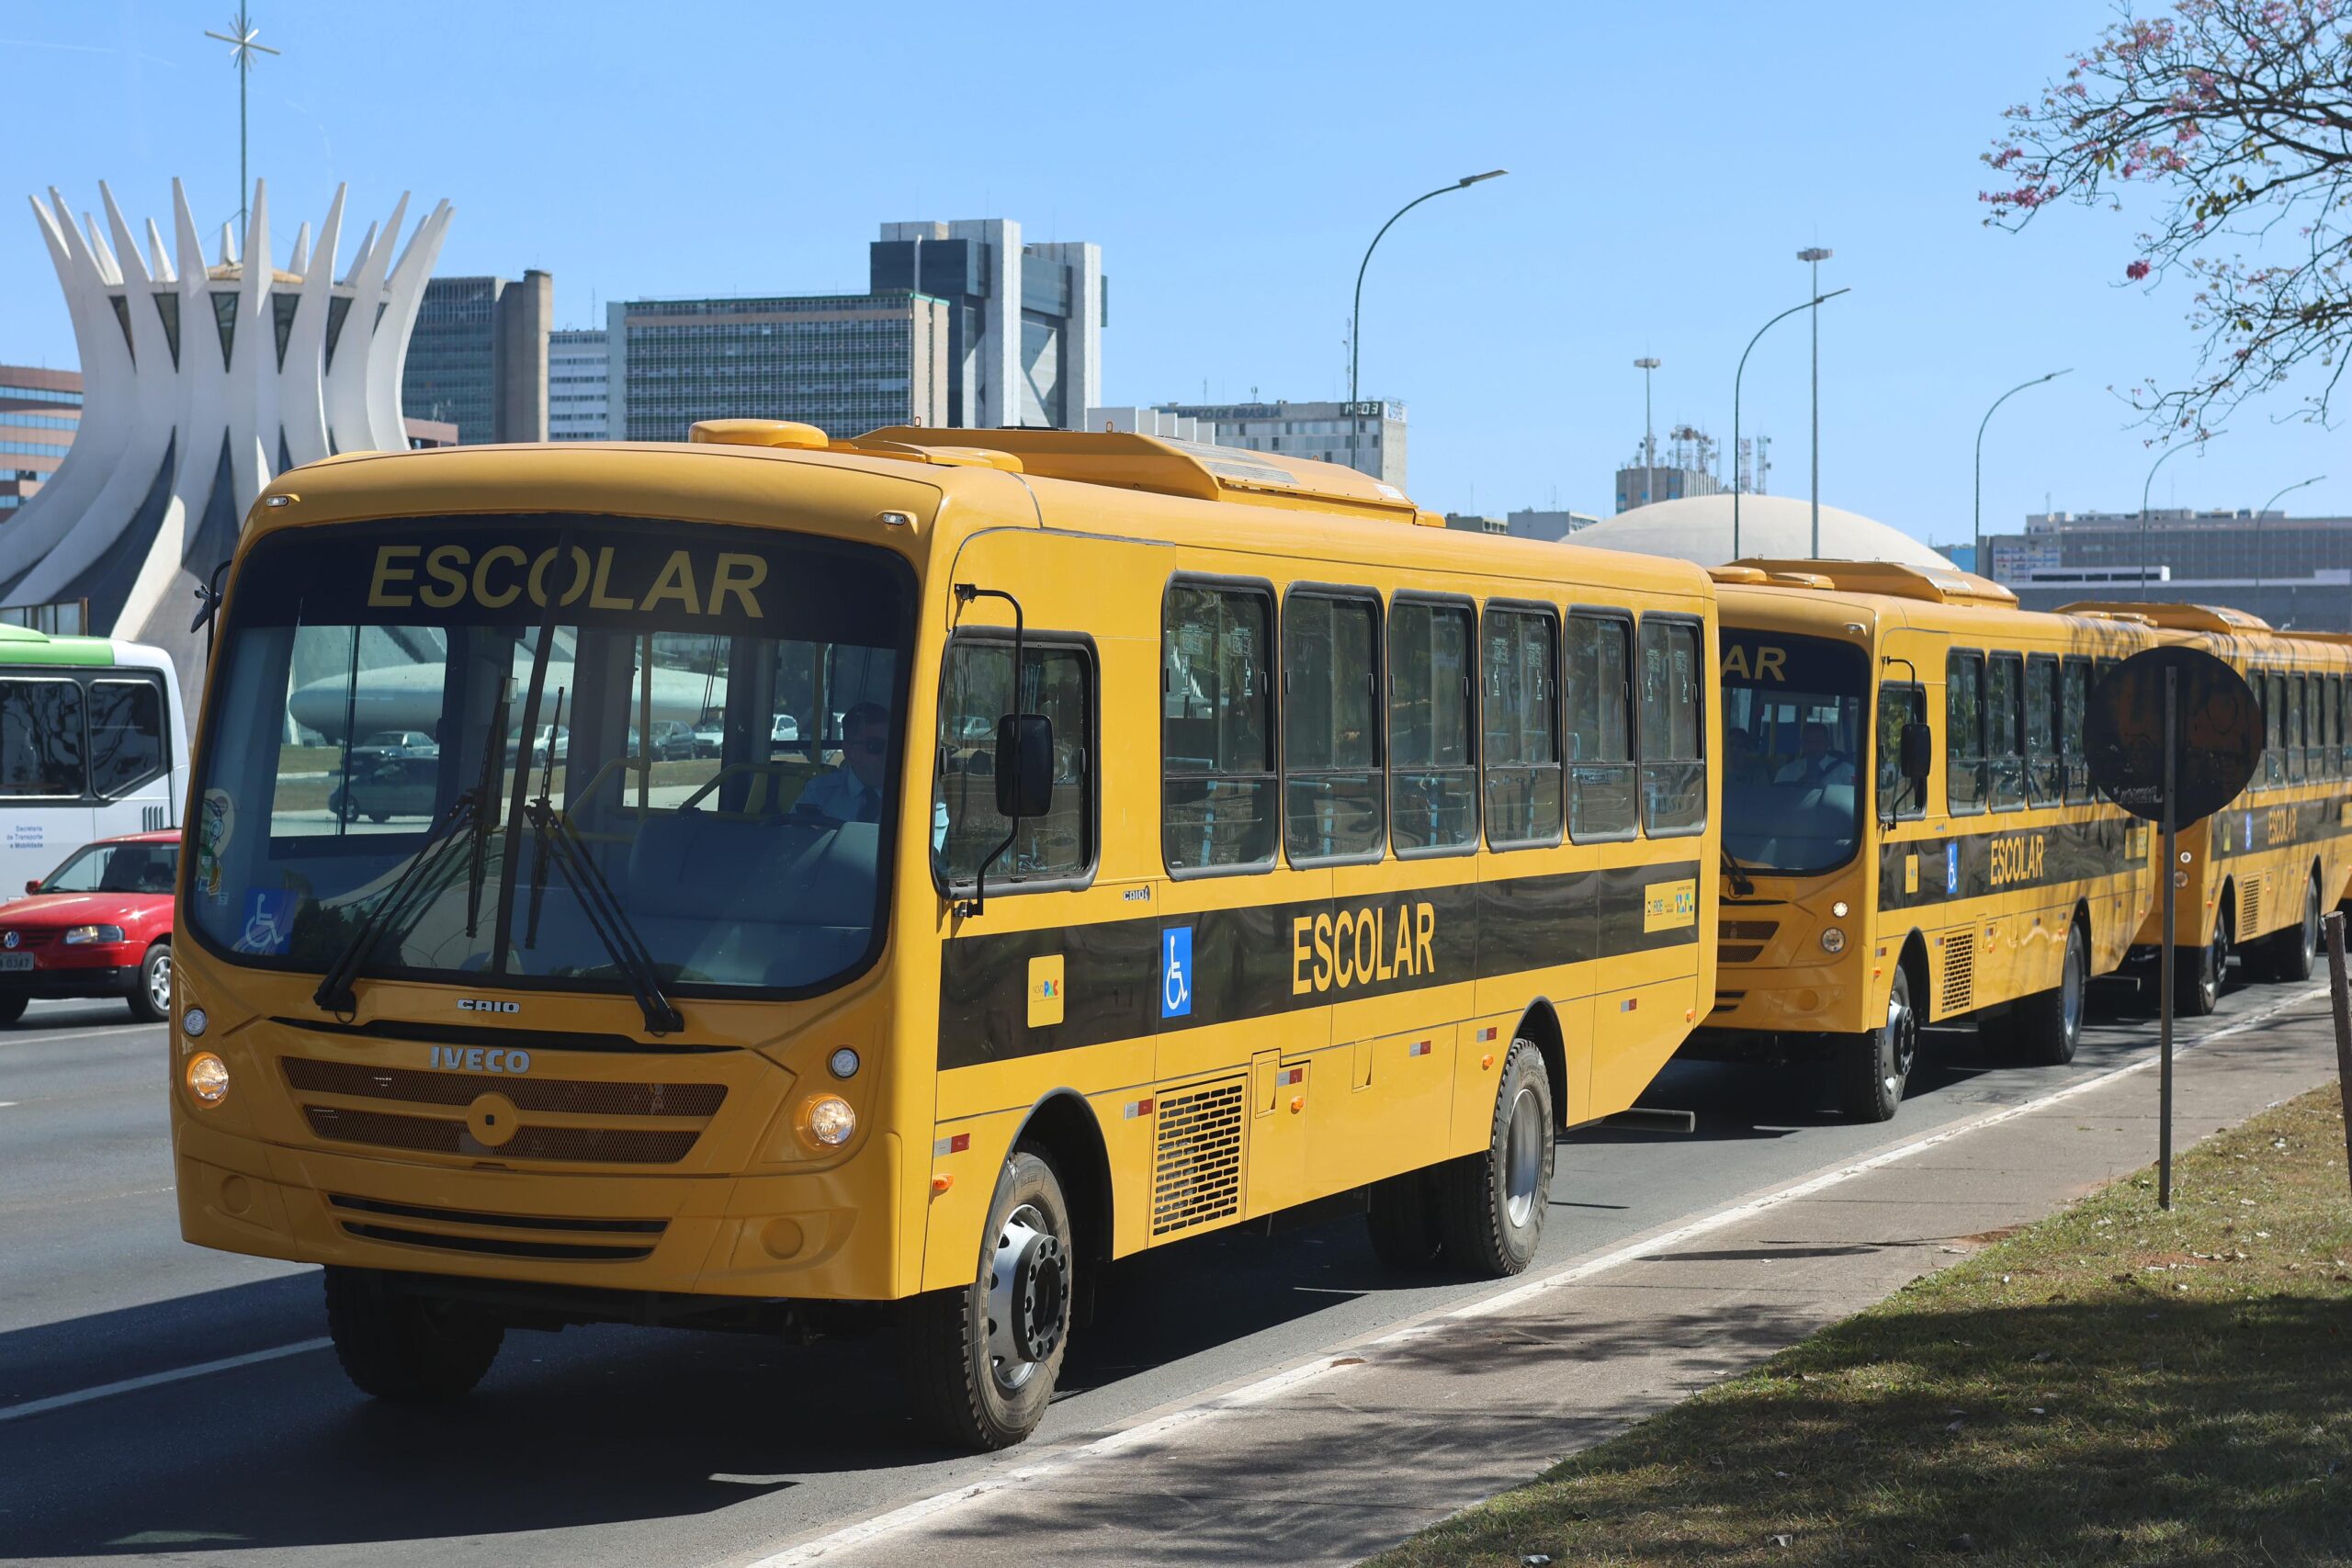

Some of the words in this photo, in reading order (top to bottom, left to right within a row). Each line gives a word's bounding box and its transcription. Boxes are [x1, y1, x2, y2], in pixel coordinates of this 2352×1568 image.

[368, 544, 768, 618] ESCOLAR
[2268, 807, 2297, 845] ESCOLAR
[1990, 834, 2043, 886] ESCOLAR
[1122, 889, 1146, 901] CAIO
[1293, 902, 1435, 995] ESCOLAR
[1044, 979, 1058, 998] PAC
[457, 998, 520, 1013] CAIO
[430, 1045, 530, 1074] IVECO
